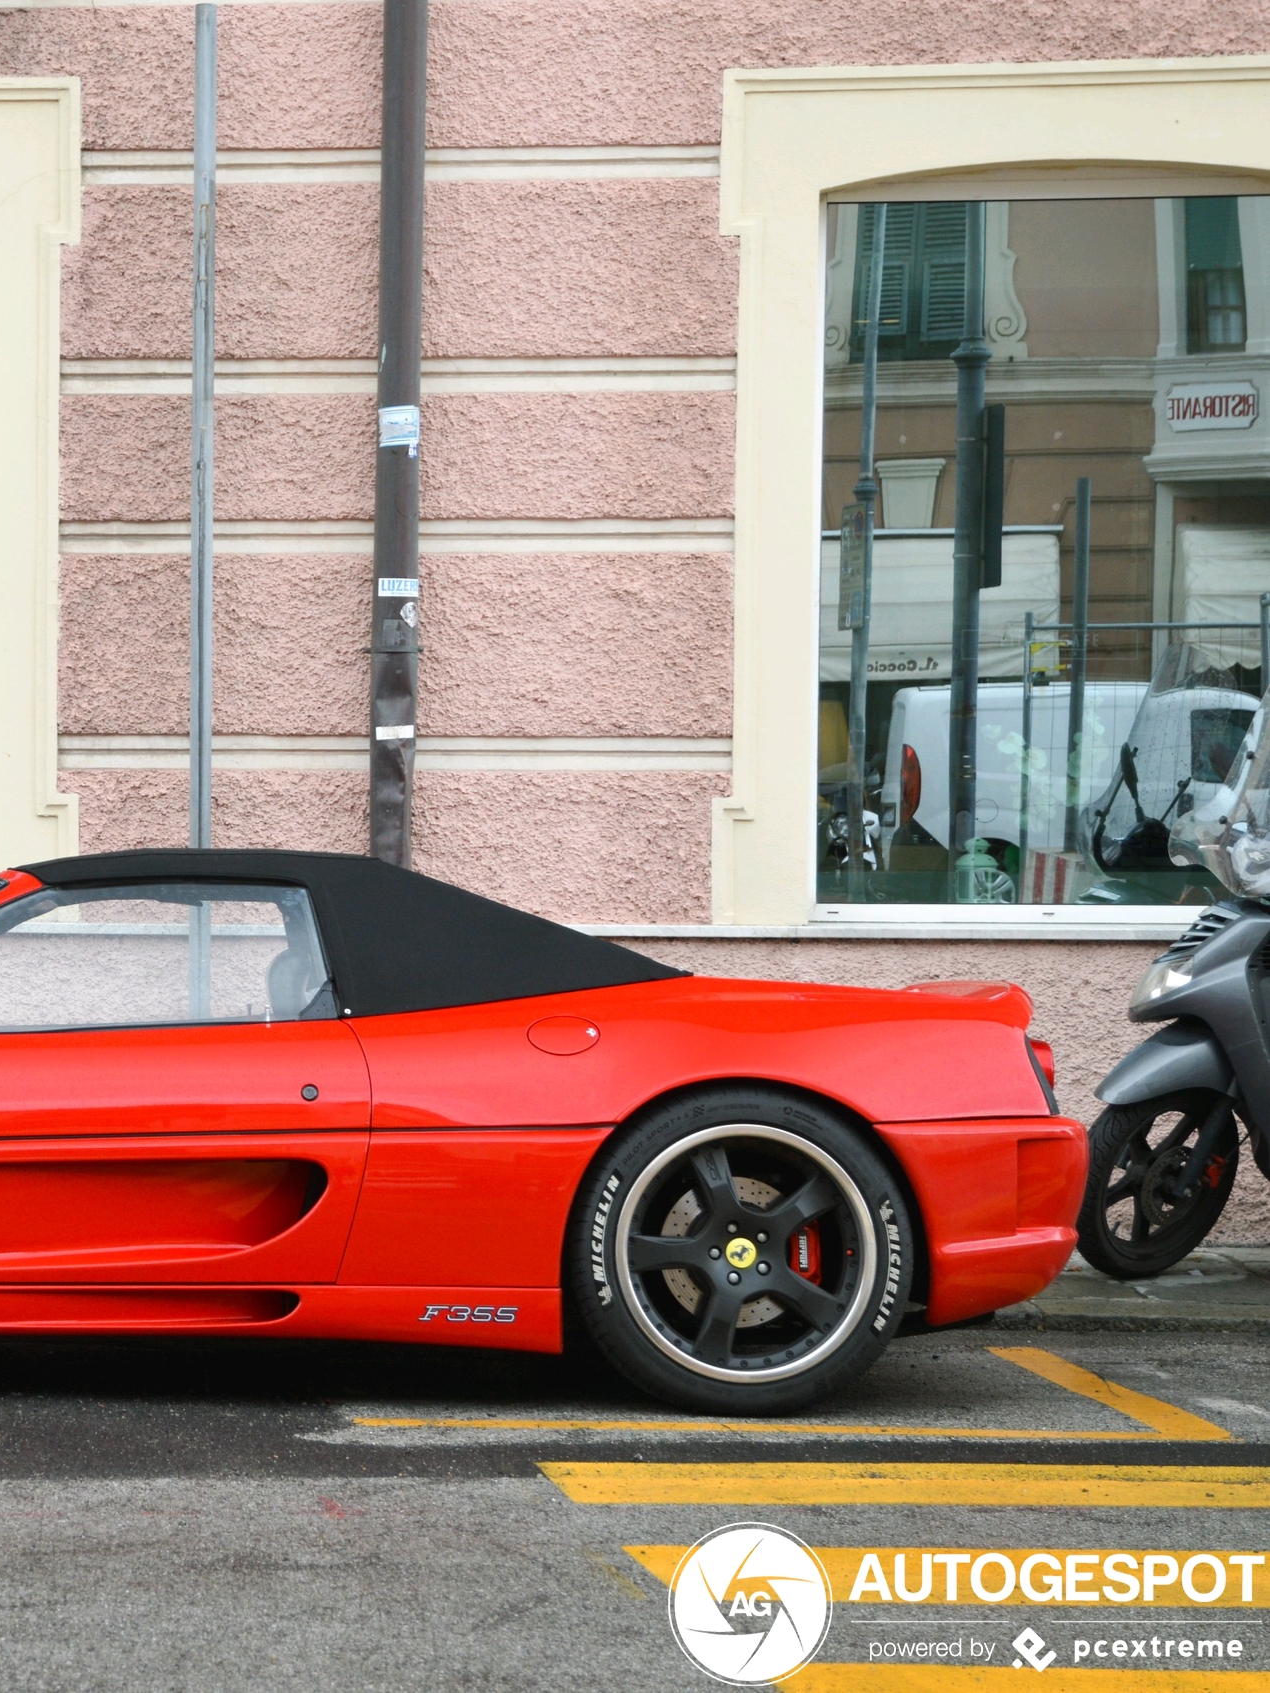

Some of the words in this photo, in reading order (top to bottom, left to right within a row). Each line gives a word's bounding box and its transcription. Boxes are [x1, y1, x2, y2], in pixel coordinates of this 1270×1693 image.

[622, 1140, 644, 1165] PILOT
[646, 1118, 676, 1144] SPORT
[591, 1174, 620, 1282] MICHELIN
[799, 1235, 808, 1268] Ferrari
[873, 1224, 901, 1331] MICHELIN
[418, 1304, 518, 1322] F355
